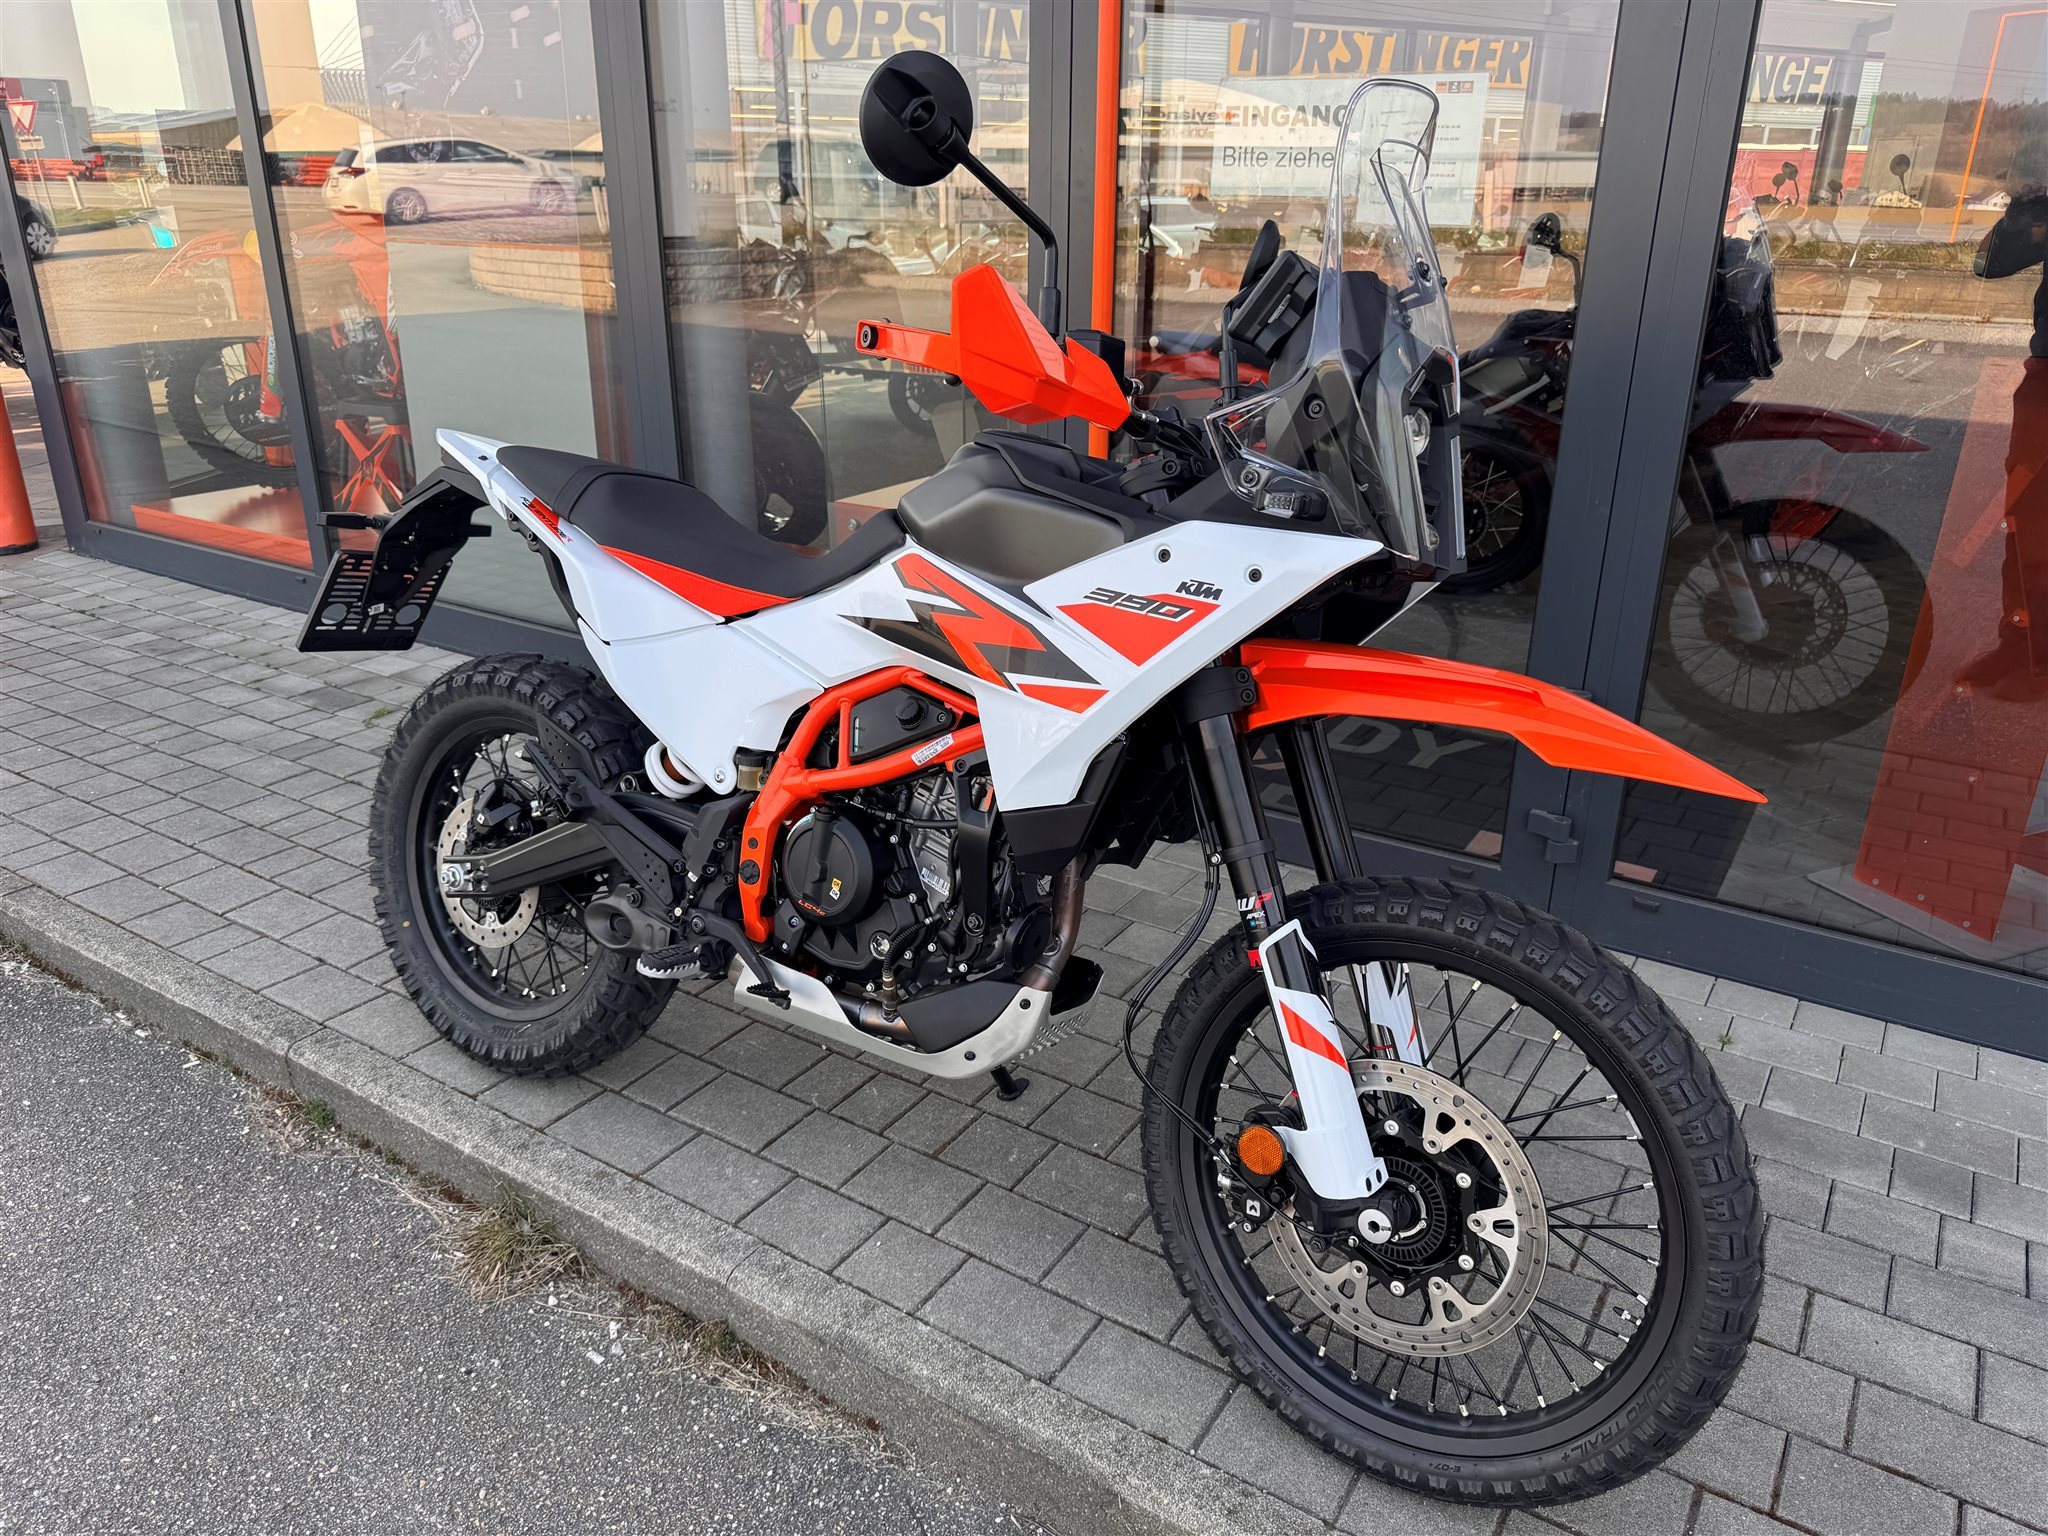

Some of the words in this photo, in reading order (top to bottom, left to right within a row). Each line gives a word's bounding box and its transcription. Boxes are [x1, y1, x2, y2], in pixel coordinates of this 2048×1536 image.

[1222, 146, 1268, 168] Bitte
[1175, 578, 1223, 601] KTM
[1082, 586, 1194, 620] 390
[1237, 892, 1273, 912] WP
